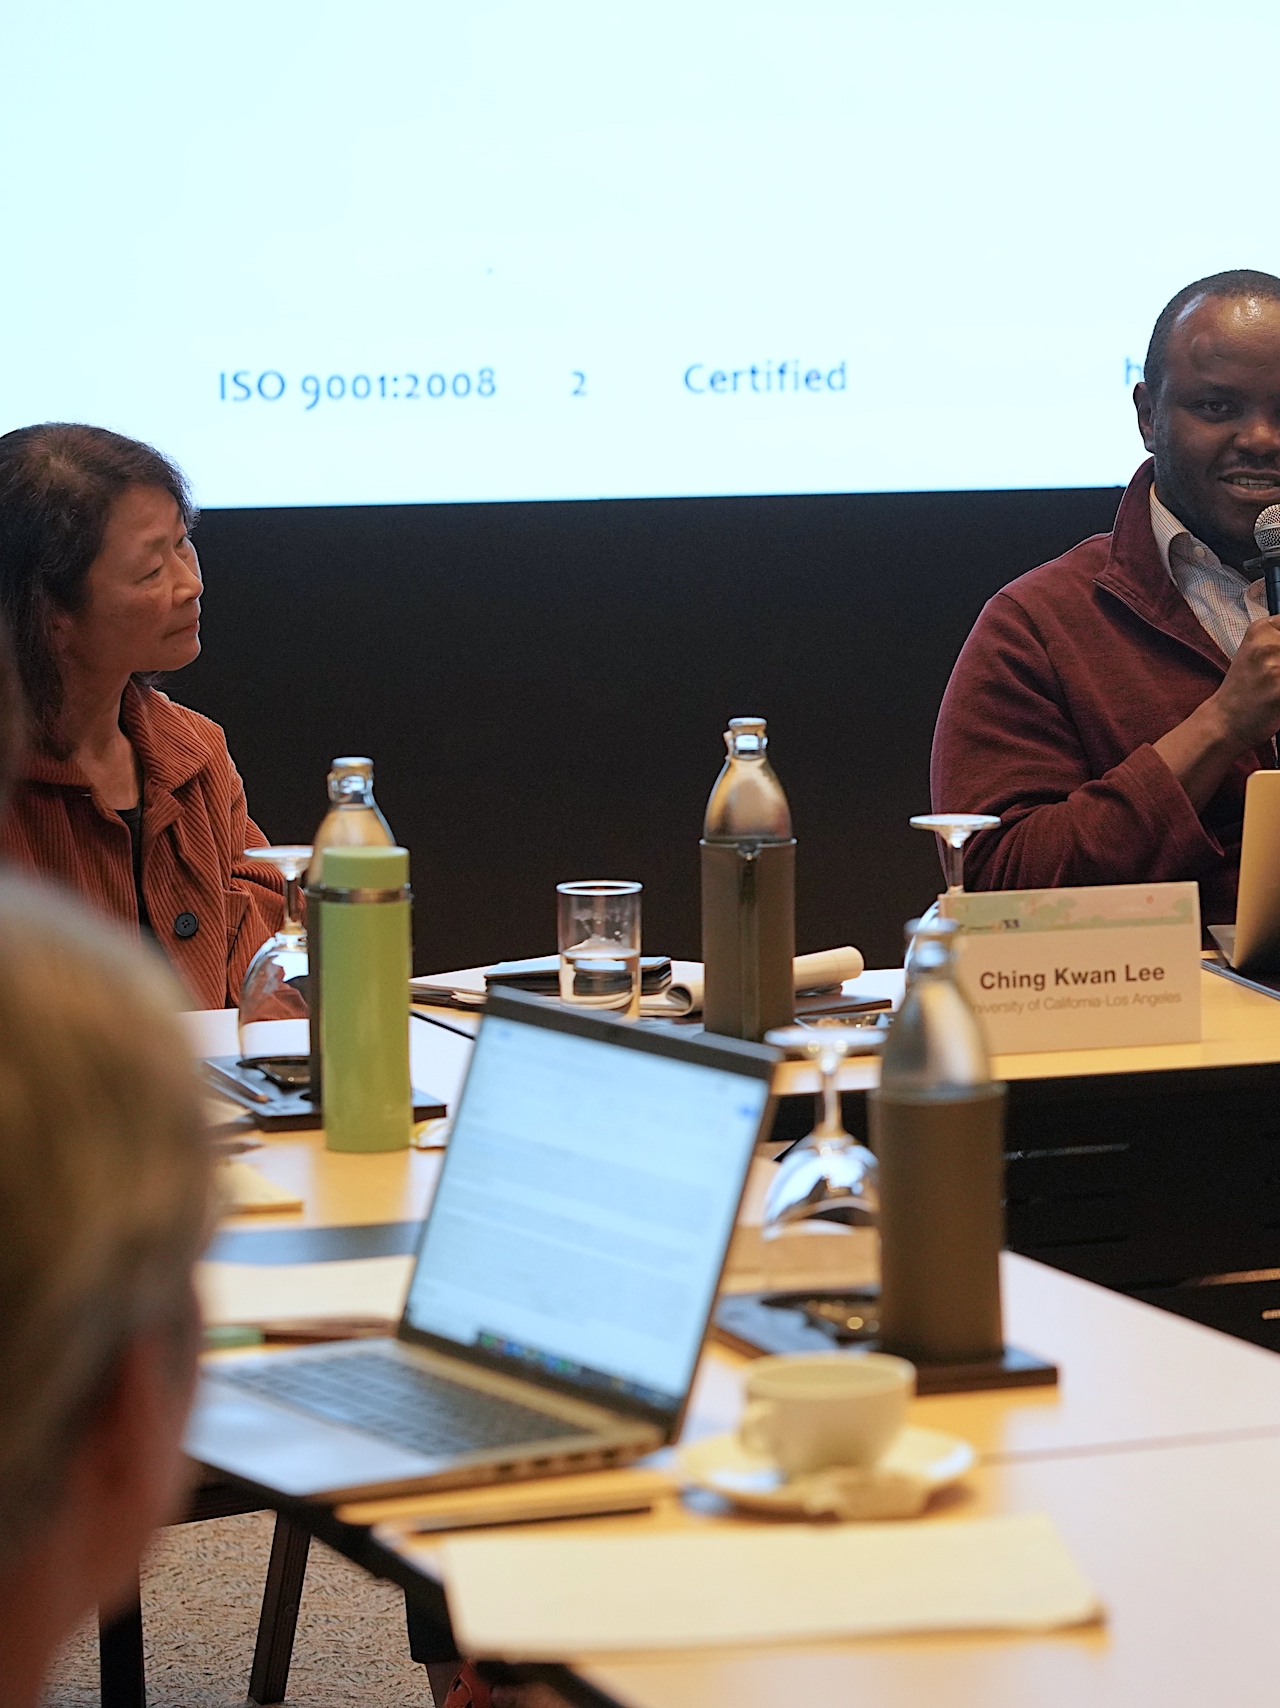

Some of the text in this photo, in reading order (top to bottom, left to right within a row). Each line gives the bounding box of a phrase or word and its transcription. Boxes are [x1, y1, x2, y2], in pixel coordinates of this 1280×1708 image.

[218, 369, 287, 402] ISO
[299, 366, 497, 411] 9001:2008
[571, 369, 588, 397] 2
[682, 360, 848, 394] Certified
[979, 964, 1165, 992] Ching Kwan Lee
[971, 1000, 1025, 1016] niversity
[1027, 997, 1041, 1012] of
[1131, 990, 1183, 1009] Angeles
